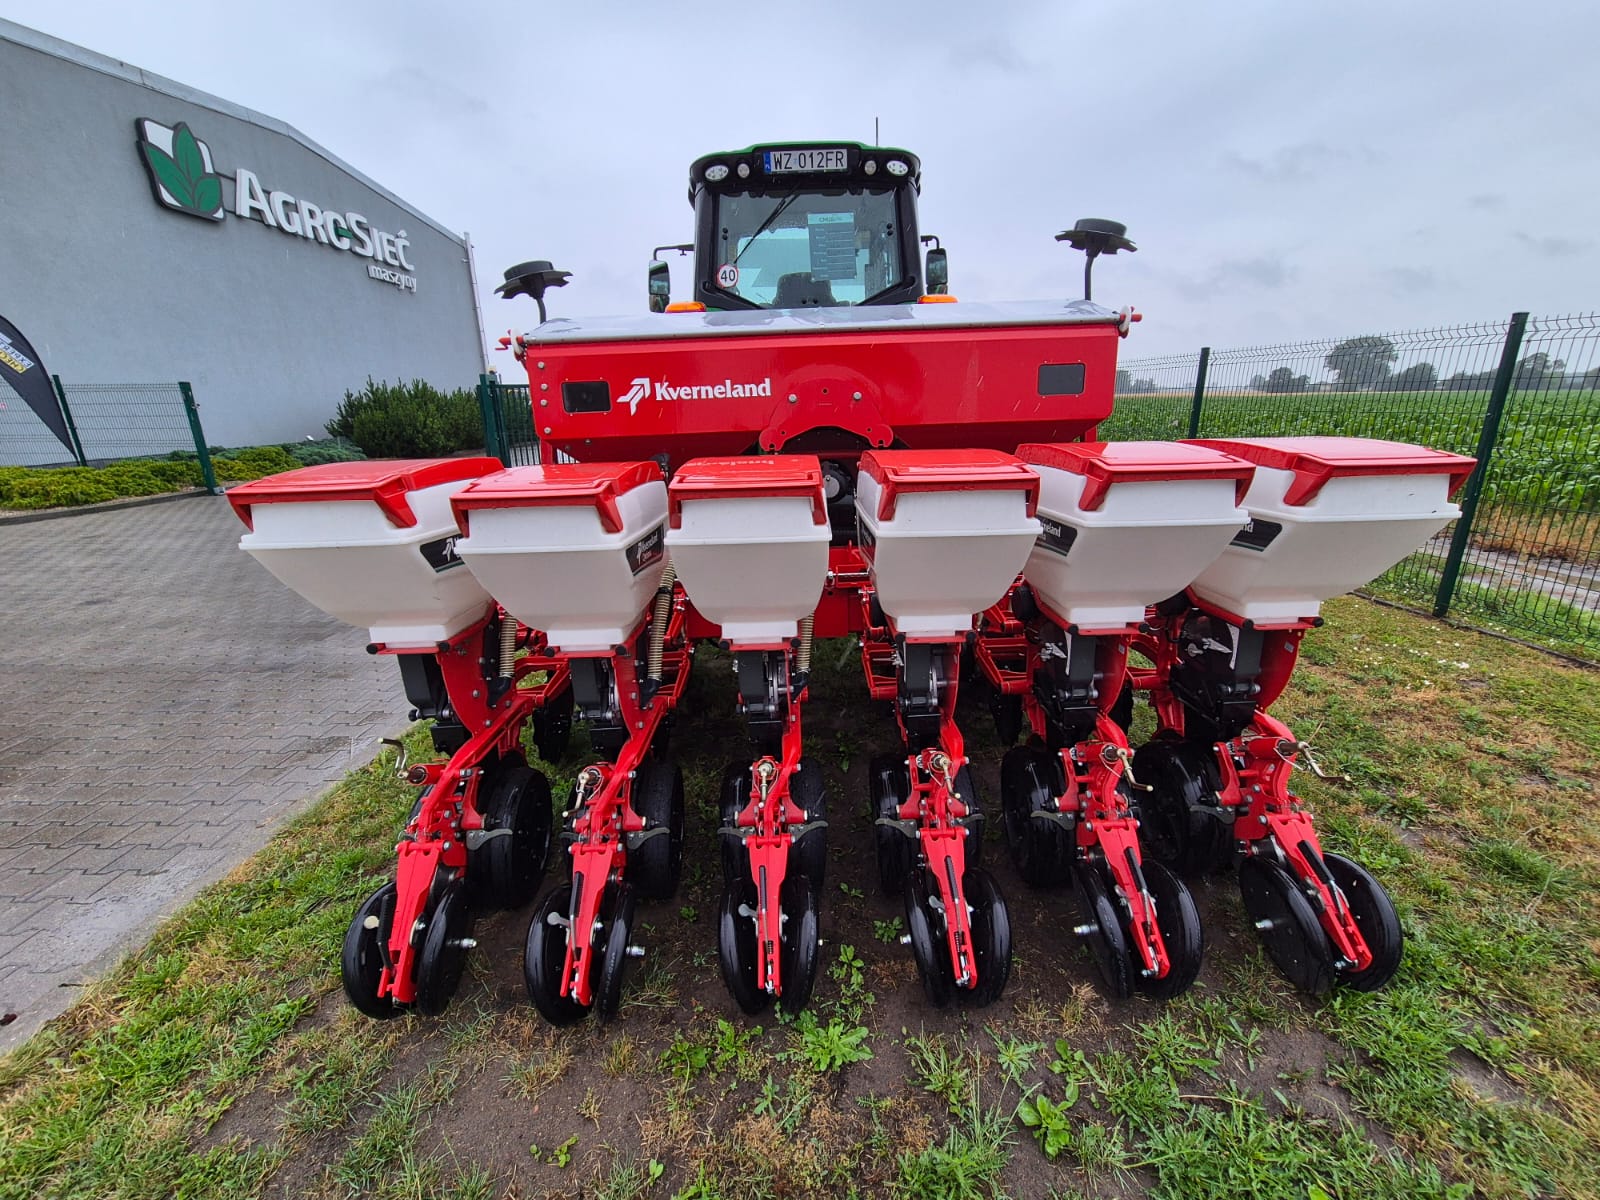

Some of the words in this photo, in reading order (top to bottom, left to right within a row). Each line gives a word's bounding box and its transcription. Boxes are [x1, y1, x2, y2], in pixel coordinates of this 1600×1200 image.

[773, 152, 793, 170] WZ
[798, 150, 845, 169] 012FR
[367, 264, 417, 293] maszyny
[720, 269, 736, 282] 40
[654, 377, 771, 401] Kverneland
